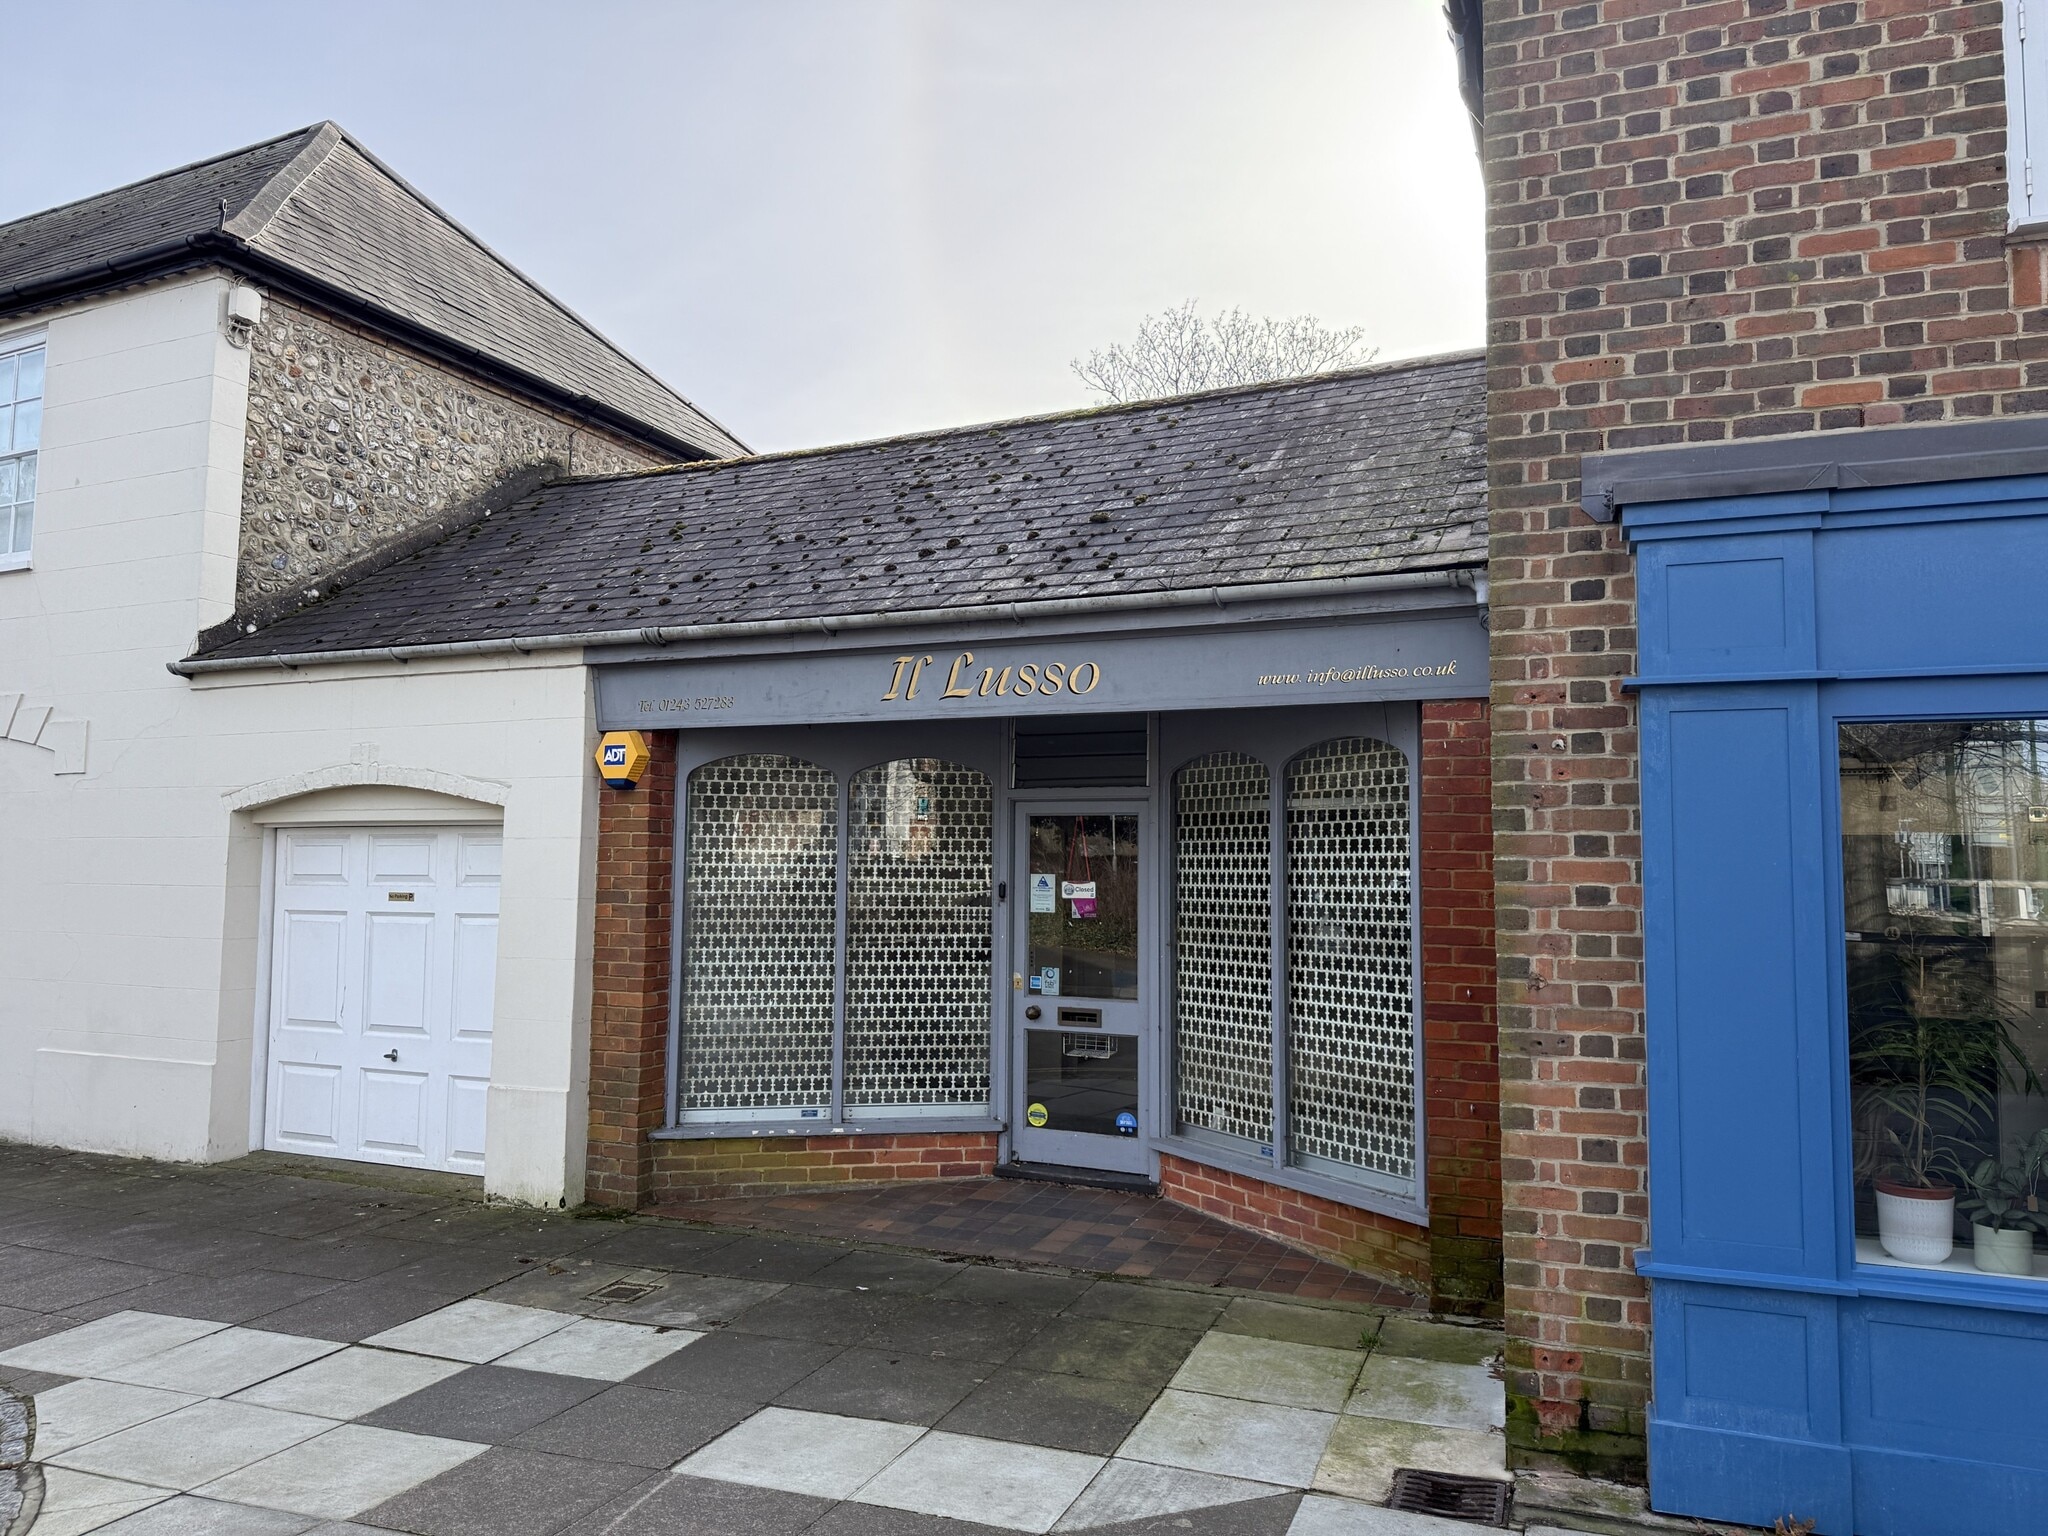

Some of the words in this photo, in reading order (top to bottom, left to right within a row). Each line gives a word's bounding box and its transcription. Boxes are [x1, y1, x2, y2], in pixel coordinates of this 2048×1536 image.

[881, 655, 933, 701] Il
[938, 651, 1100, 701] Lusso
[658, 698, 690, 712] 01243
[604, 748, 626, 762] ADT
